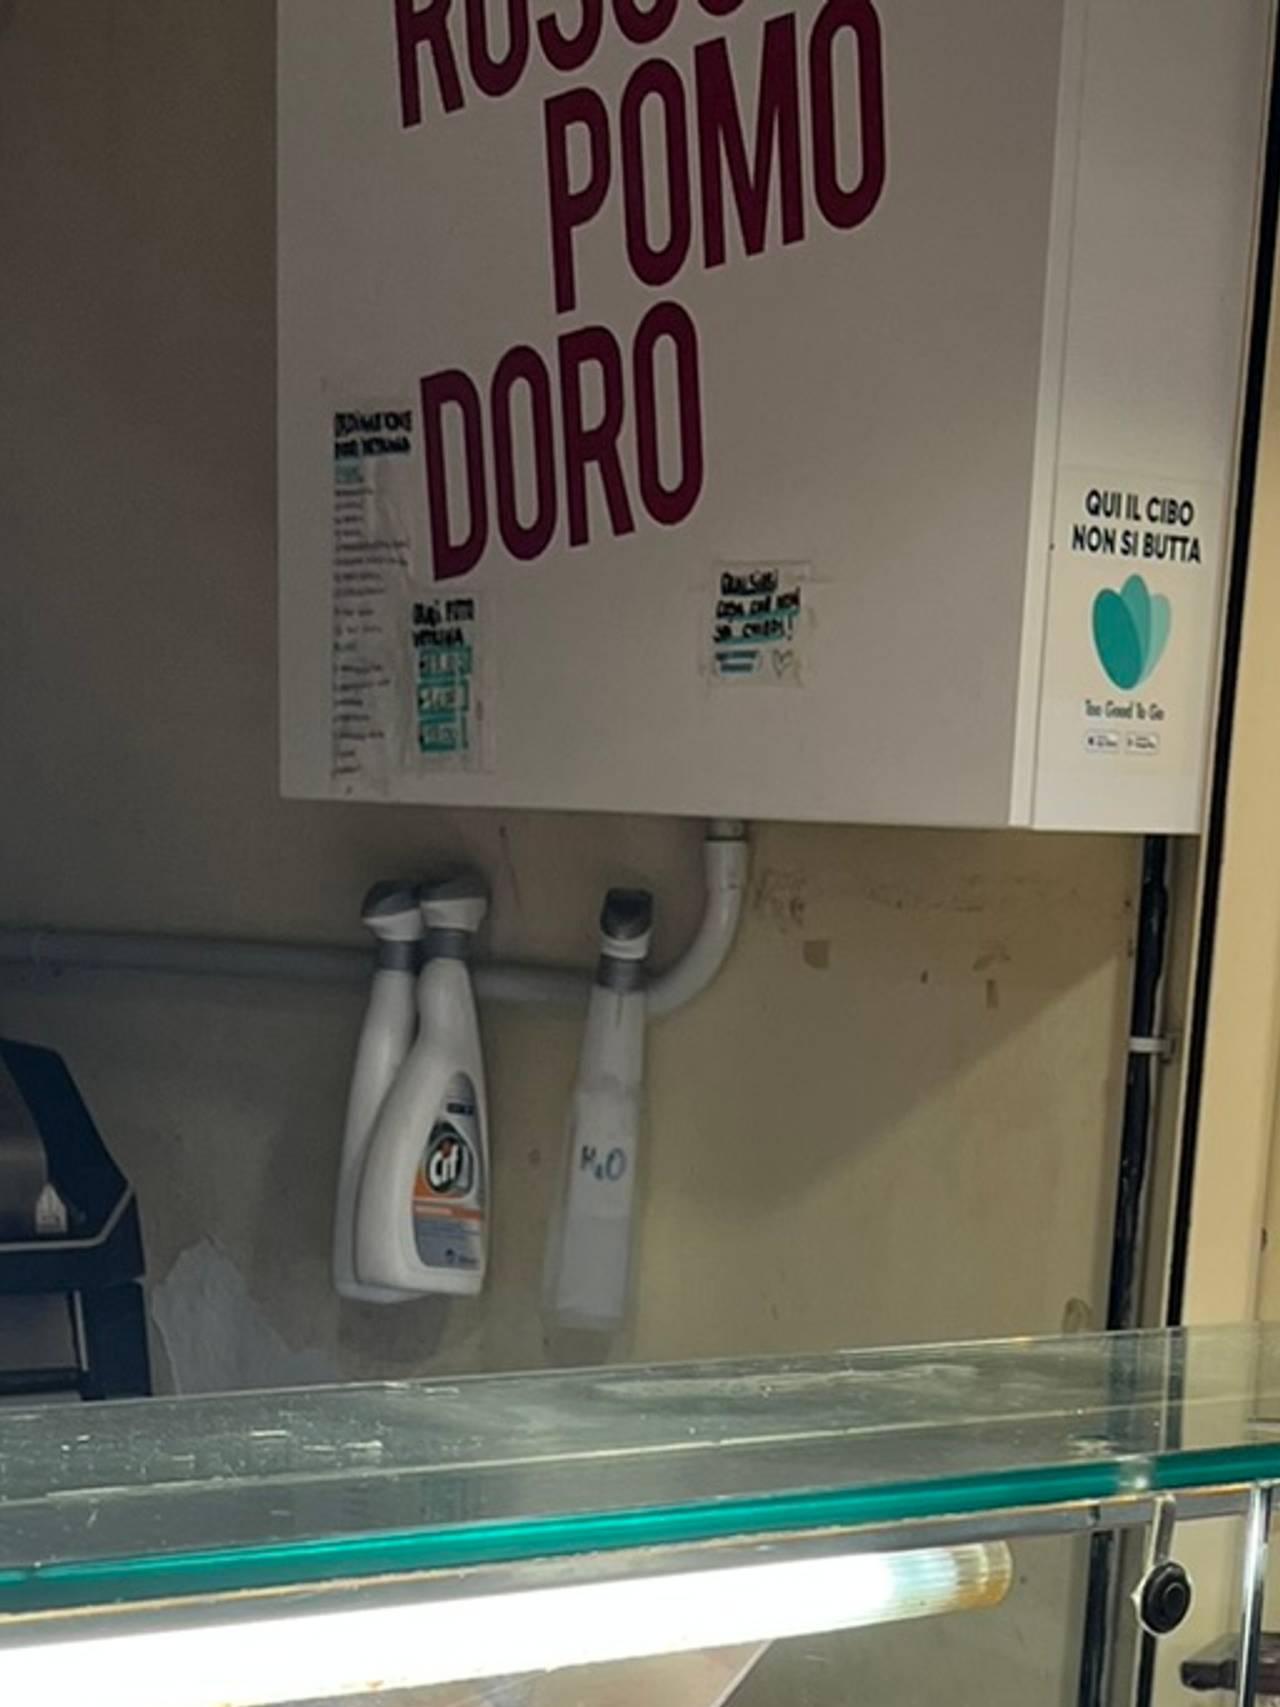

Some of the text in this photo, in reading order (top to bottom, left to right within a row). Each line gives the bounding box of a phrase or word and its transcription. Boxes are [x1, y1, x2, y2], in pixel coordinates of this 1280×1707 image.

[544, 0, 886, 314] POMO
[420, 301, 704, 581] DORO
[1086, 489, 1194, 526] QUI IL CIBO
[1072, 524, 1201, 564] NON SI BUTTA
